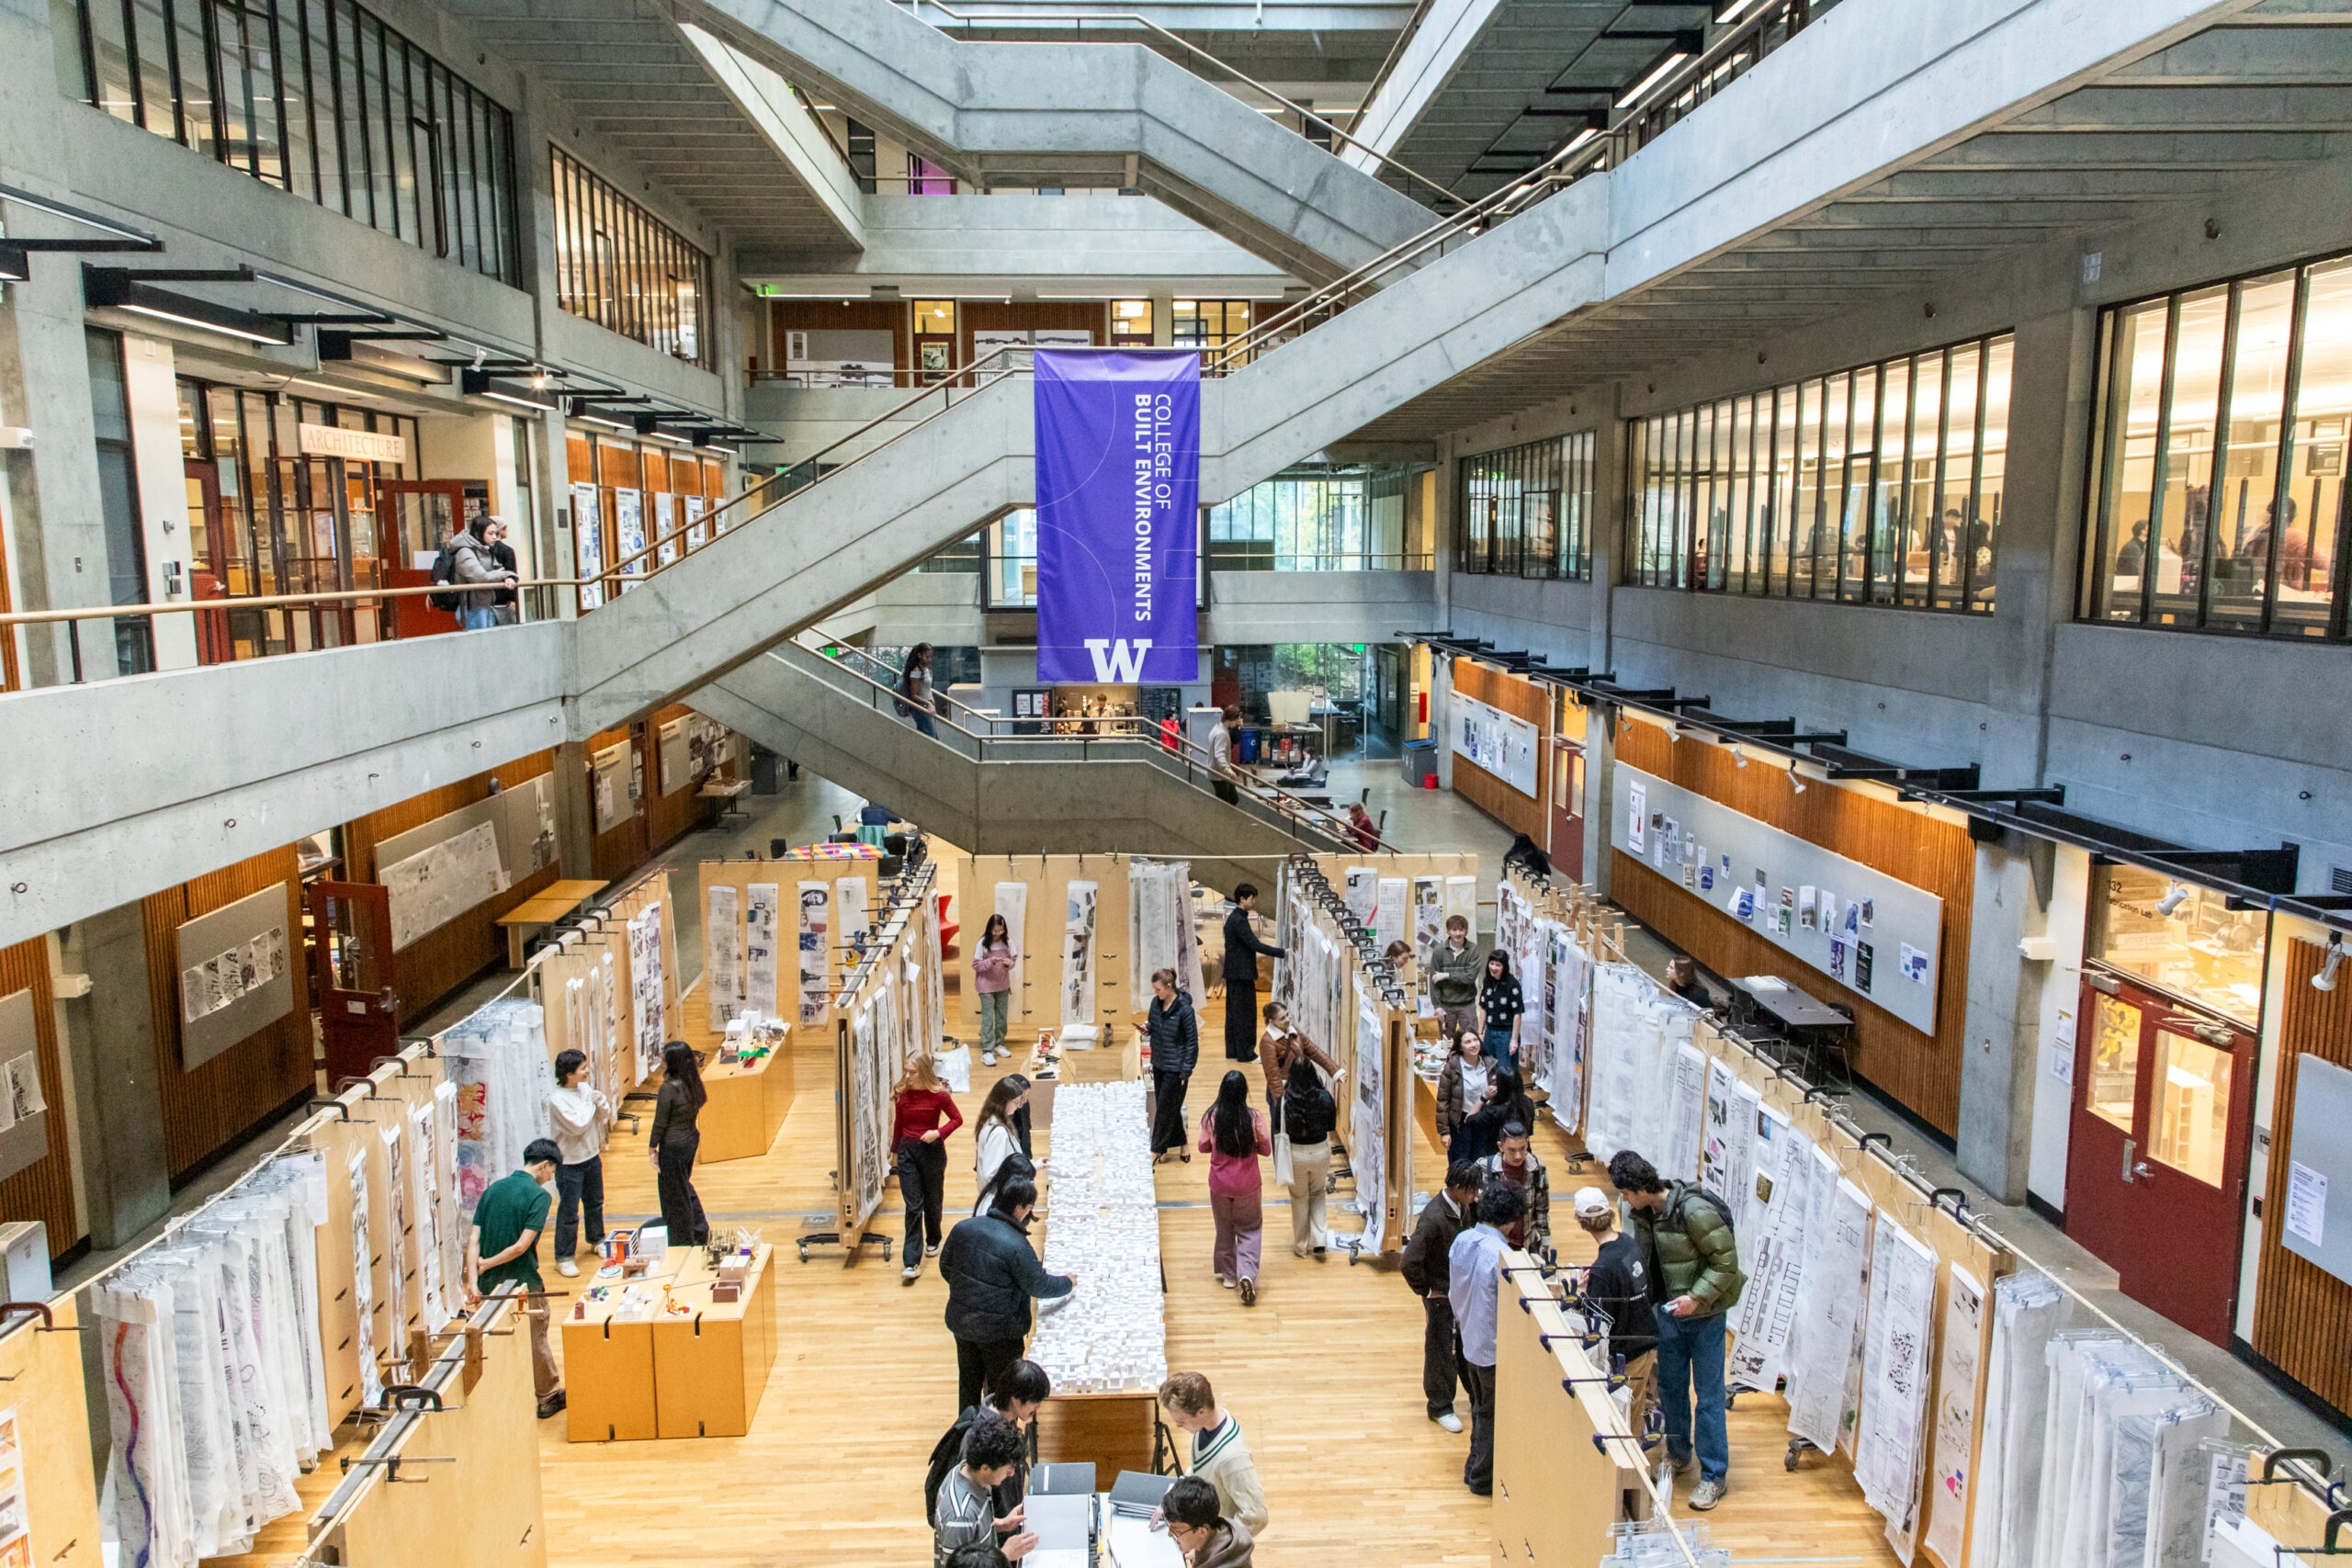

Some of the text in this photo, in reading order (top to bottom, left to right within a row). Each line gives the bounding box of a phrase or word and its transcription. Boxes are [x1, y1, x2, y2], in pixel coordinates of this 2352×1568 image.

[307, 429, 401, 458] ARCHITECTURE
[1155, 393, 1171, 510] COLLEGE OF
[1135, 394, 1151, 622] BUILT ENVIRONMENTS
[1083, 638, 1152, 683] W
[2108, 879, 2122, 894] 132
[2106, 895, 2153, 919] Fabrication Lab
